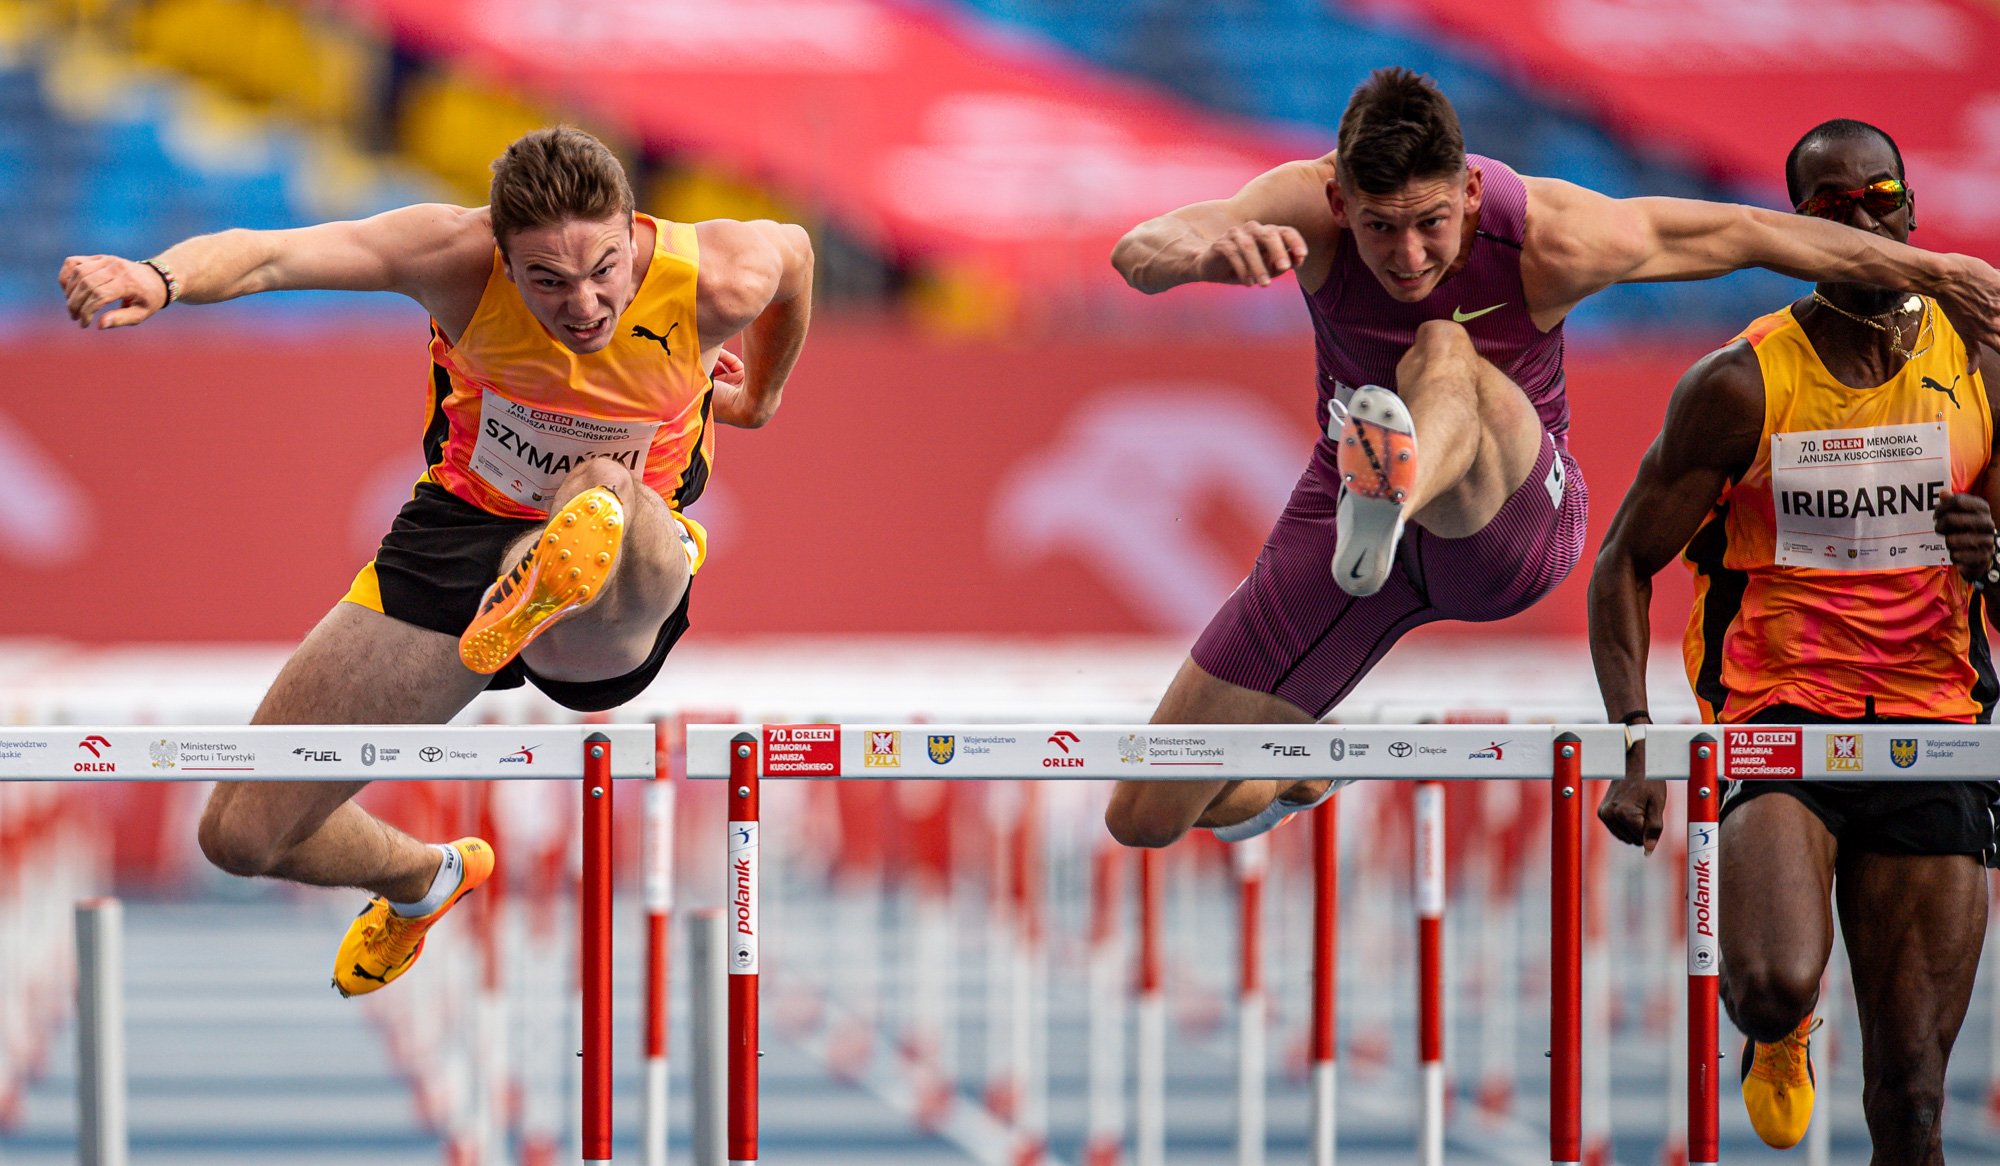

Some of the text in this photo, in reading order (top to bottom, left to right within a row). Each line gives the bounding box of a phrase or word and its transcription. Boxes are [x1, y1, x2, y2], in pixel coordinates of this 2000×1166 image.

[510, 401, 628, 434] 70. ORLEN MEMORIAŁ
[506, 408, 630, 441] JANUSZA KUSOCIŃSKIEGO
[1801, 434, 1918, 453] 70. ORLEN MEMORIAŁ
[1797, 446, 1923, 464] JANUSZA KUSOCIŃSKIEGO
[1781, 480, 1945, 519] IRIBARNE
[769, 729, 831, 742] 70. ORLEN
[963, 736, 1016, 745] Województwo
[1730, 732, 1793, 745] 70. ORLEN
[1149, 736, 1206, 746] Ministerstwo
[1926, 740, 1980, 748] Województwo
[180, 742, 237, 751] Ministerstwo
[769, 743, 812, 751] MEMORIAŁ
[963, 746, 991, 755] Śląskie
[1273, 745, 1311, 757] FUEL
[1419, 746, 1447, 756] Okęcie
[1730, 747, 1774, 755] MEMORIAŁ
[180, 752, 209, 762] Sportu
[216, 752, 256, 762] Turystyki
[304, 751, 342, 761] FUEL
[449, 750, 478, 761] Okęcie
[769, 753, 805, 761] JANUSZA
[1149, 748, 1178, 757] Sportu
[1185, 747, 1225, 757] Turystyki
[1468, 752, 1496, 760] polanik
[1926, 750, 1954, 759] Śląskie
[499, 756, 526, 764] polanik
[866, 755, 898, 766] PZLA
[1042, 758, 1084, 767] ORLEN
[1730, 757, 1767, 765] JANUSZA
[1828, 759, 1861, 769] PZLA
[73, 762, 116, 772] ORLEN
[769, 761, 834, 771] KUSOCIŃSKIEGO
[1730, 765, 1796, 775] KUSOCIŃSKIEGO
[733, 857, 754, 936] polanik
[1693, 858, 1714, 937] polanik
